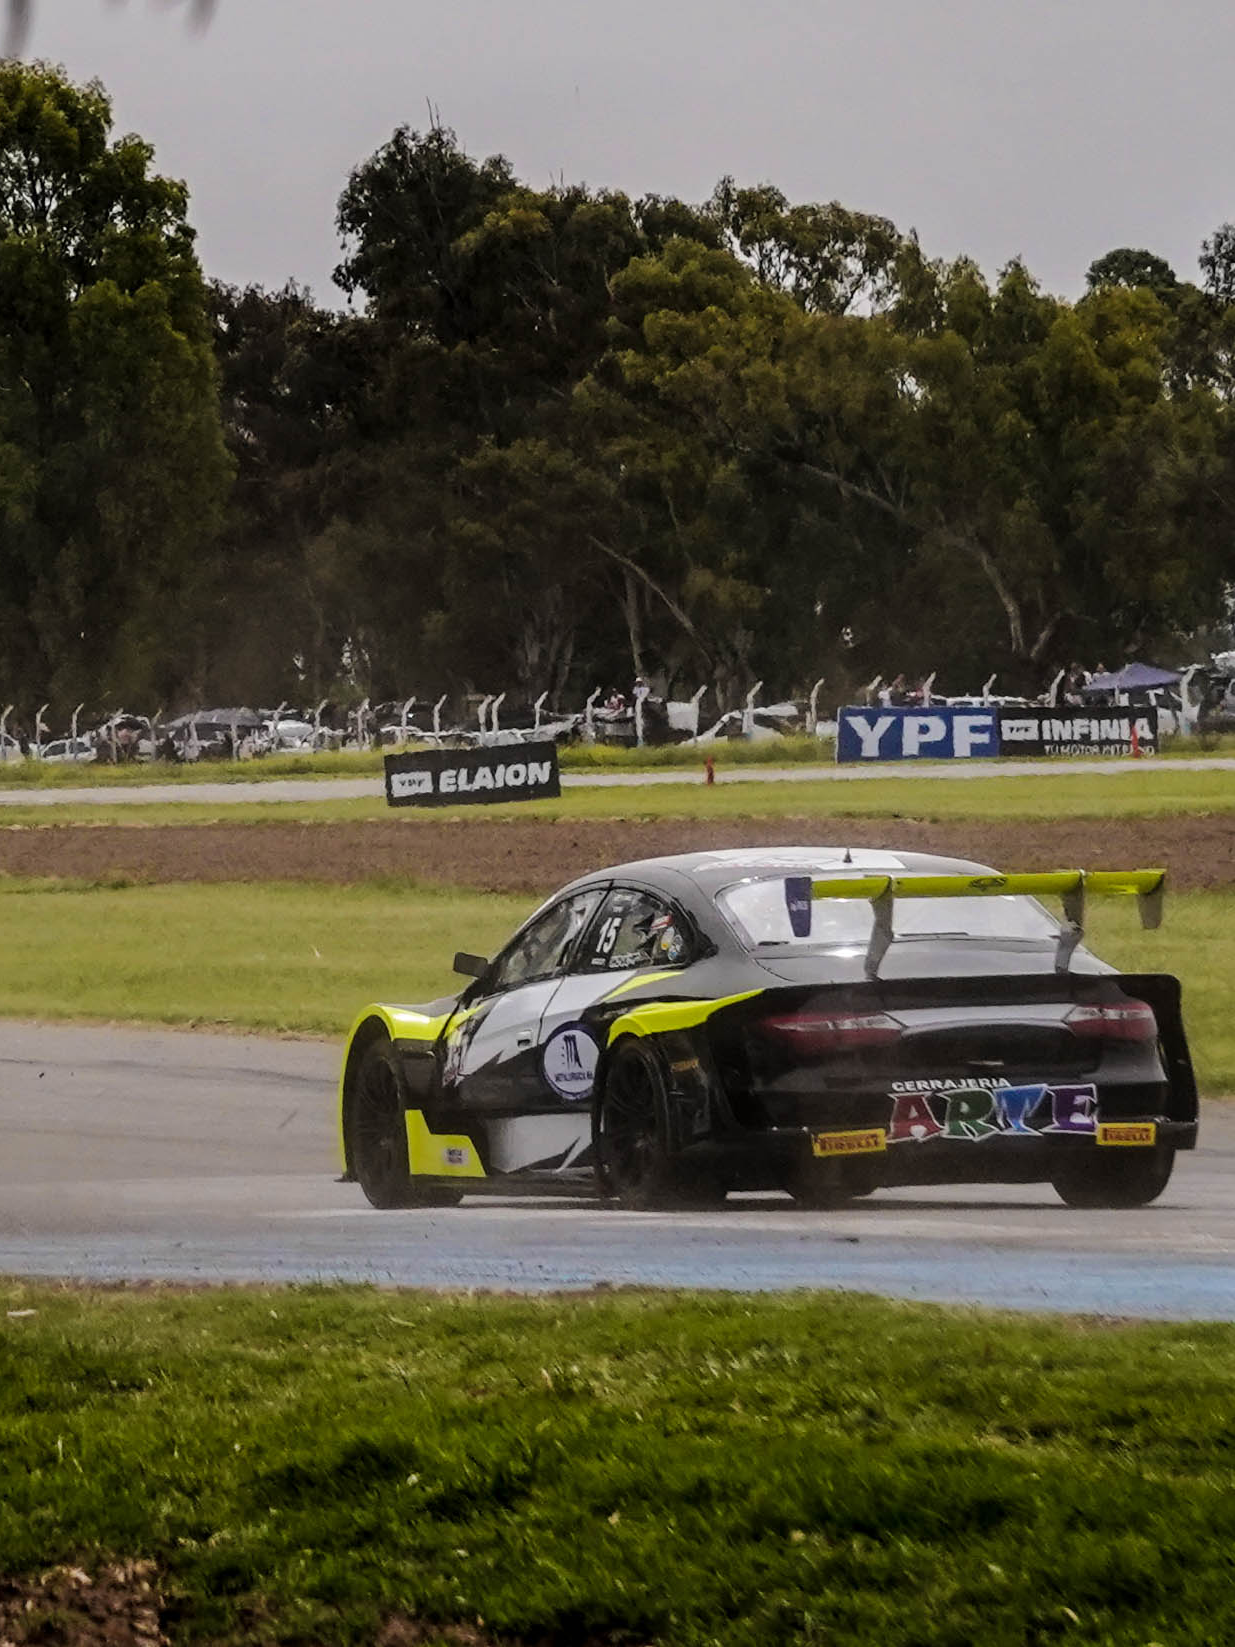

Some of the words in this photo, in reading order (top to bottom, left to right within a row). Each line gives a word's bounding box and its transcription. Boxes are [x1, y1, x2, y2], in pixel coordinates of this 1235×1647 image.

[845, 715, 993, 757] YPF
[1041, 718, 1154, 741] INFINIA
[438, 761, 552, 793] ELAION
[595, 916, 622, 954] 15
[891, 1077, 1013, 1093] CERRAJERIA
[886, 1083, 1098, 1143] ARTE
